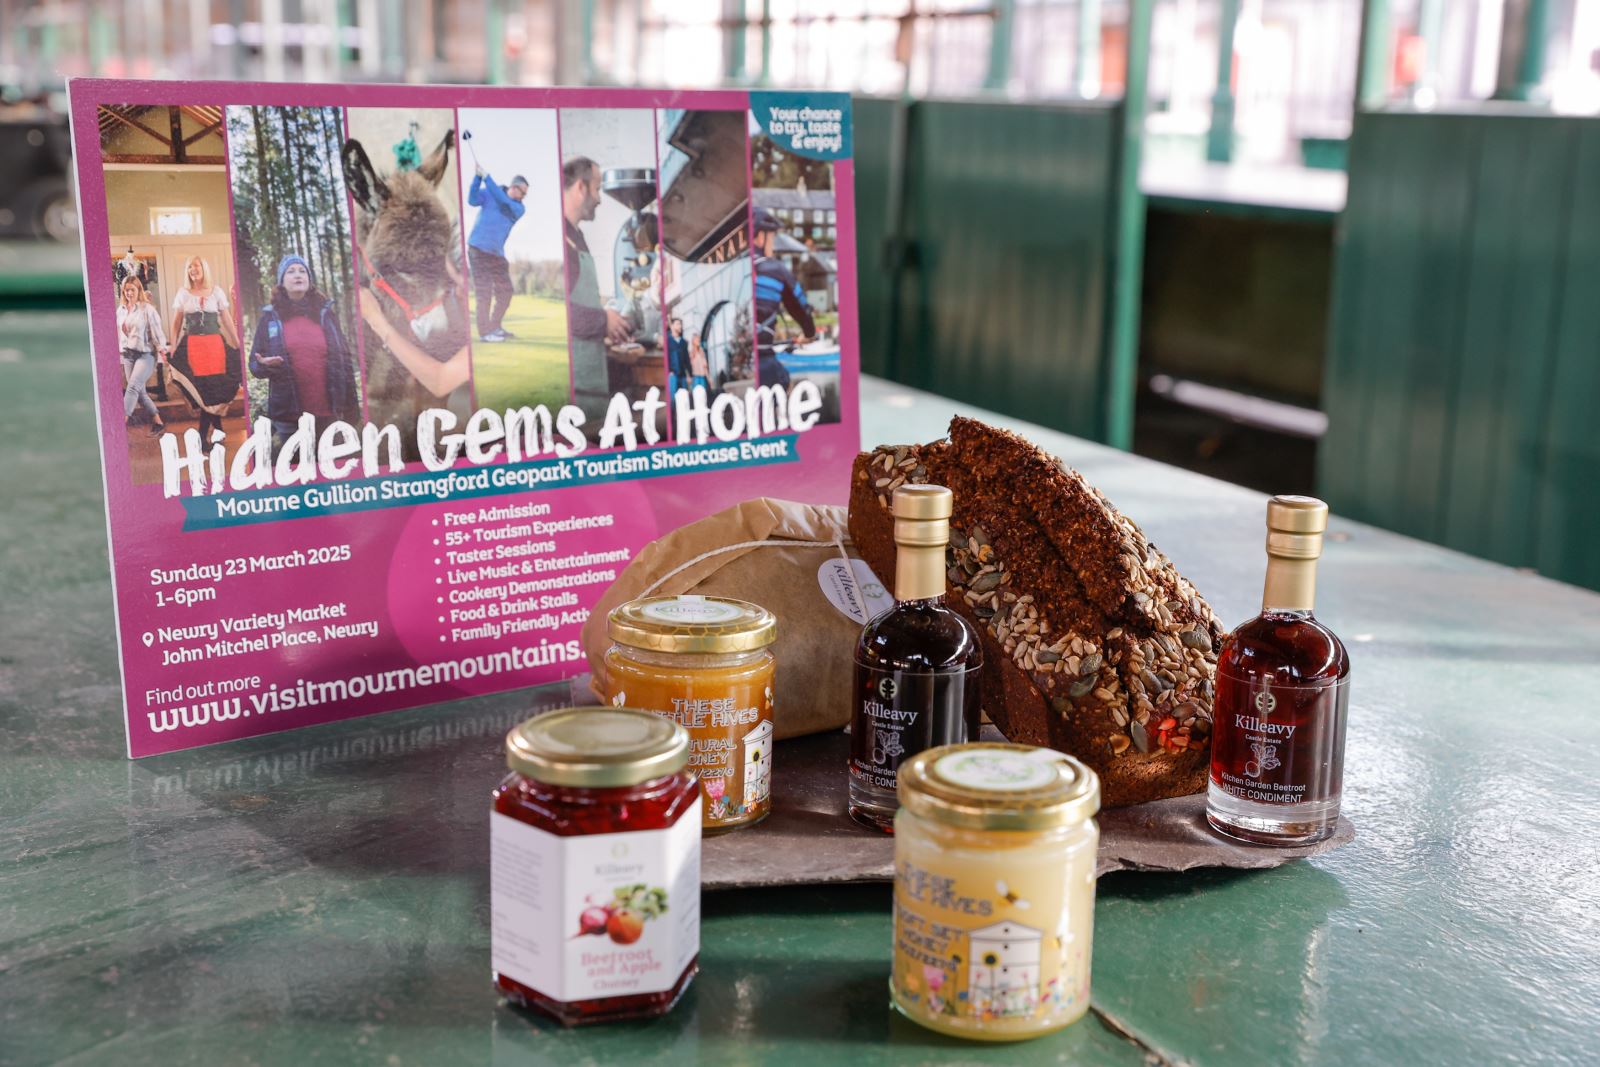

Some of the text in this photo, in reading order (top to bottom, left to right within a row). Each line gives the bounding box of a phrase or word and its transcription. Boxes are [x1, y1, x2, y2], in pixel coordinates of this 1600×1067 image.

[769, 106, 842, 121] Your chance
[769, 121, 841, 138] to try, taste
[791, 134, 842, 152] & enjoy!
[160, 381, 822, 498] Hidden Gems At Home
[216, 438, 788, 518] Mourne Gullion Strangford Geopark Tourism Showcase Event
[444, 502, 551, 527] Free Admission
[445, 513, 614, 546] 55+ Tourism Experiences
[150, 544, 351, 585] Sunday 23 March 2025
[447, 540, 556, 565] Taster Sessions
[447, 548, 630, 585] Live Music & Entertainment
[155, 586, 216, 607] 1-6pm
[449, 568, 616, 604] Cookery Demonstrations
[450, 592, 578, 623] Food & Drink Stalls
[157, 602, 347, 644] Newry Variety Market
[451, 622, 501, 642] Family
[502, 612, 559, 634] Friendly
[161, 620, 379, 666] John Mitchel Place, Newry
[145, 675, 261, 706] Find out more
[671, 697, 736, 714] THESE
[711, 707, 759, 727] HIVES
[863, 700, 919, 726] Killeavy
[1234, 713, 1296, 739] Killeavy
[1245, 734, 1262, 742] Castle
[689, 737, 737, 753] TURAL
[688, 751, 730, 766] ONEY
[873, 765, 897, 777] Garden
[1221, 771, 1306, 792] Kitchen Garden Beetroot
[1222, 782, 1303, 803] WHITE CONDIMENT
